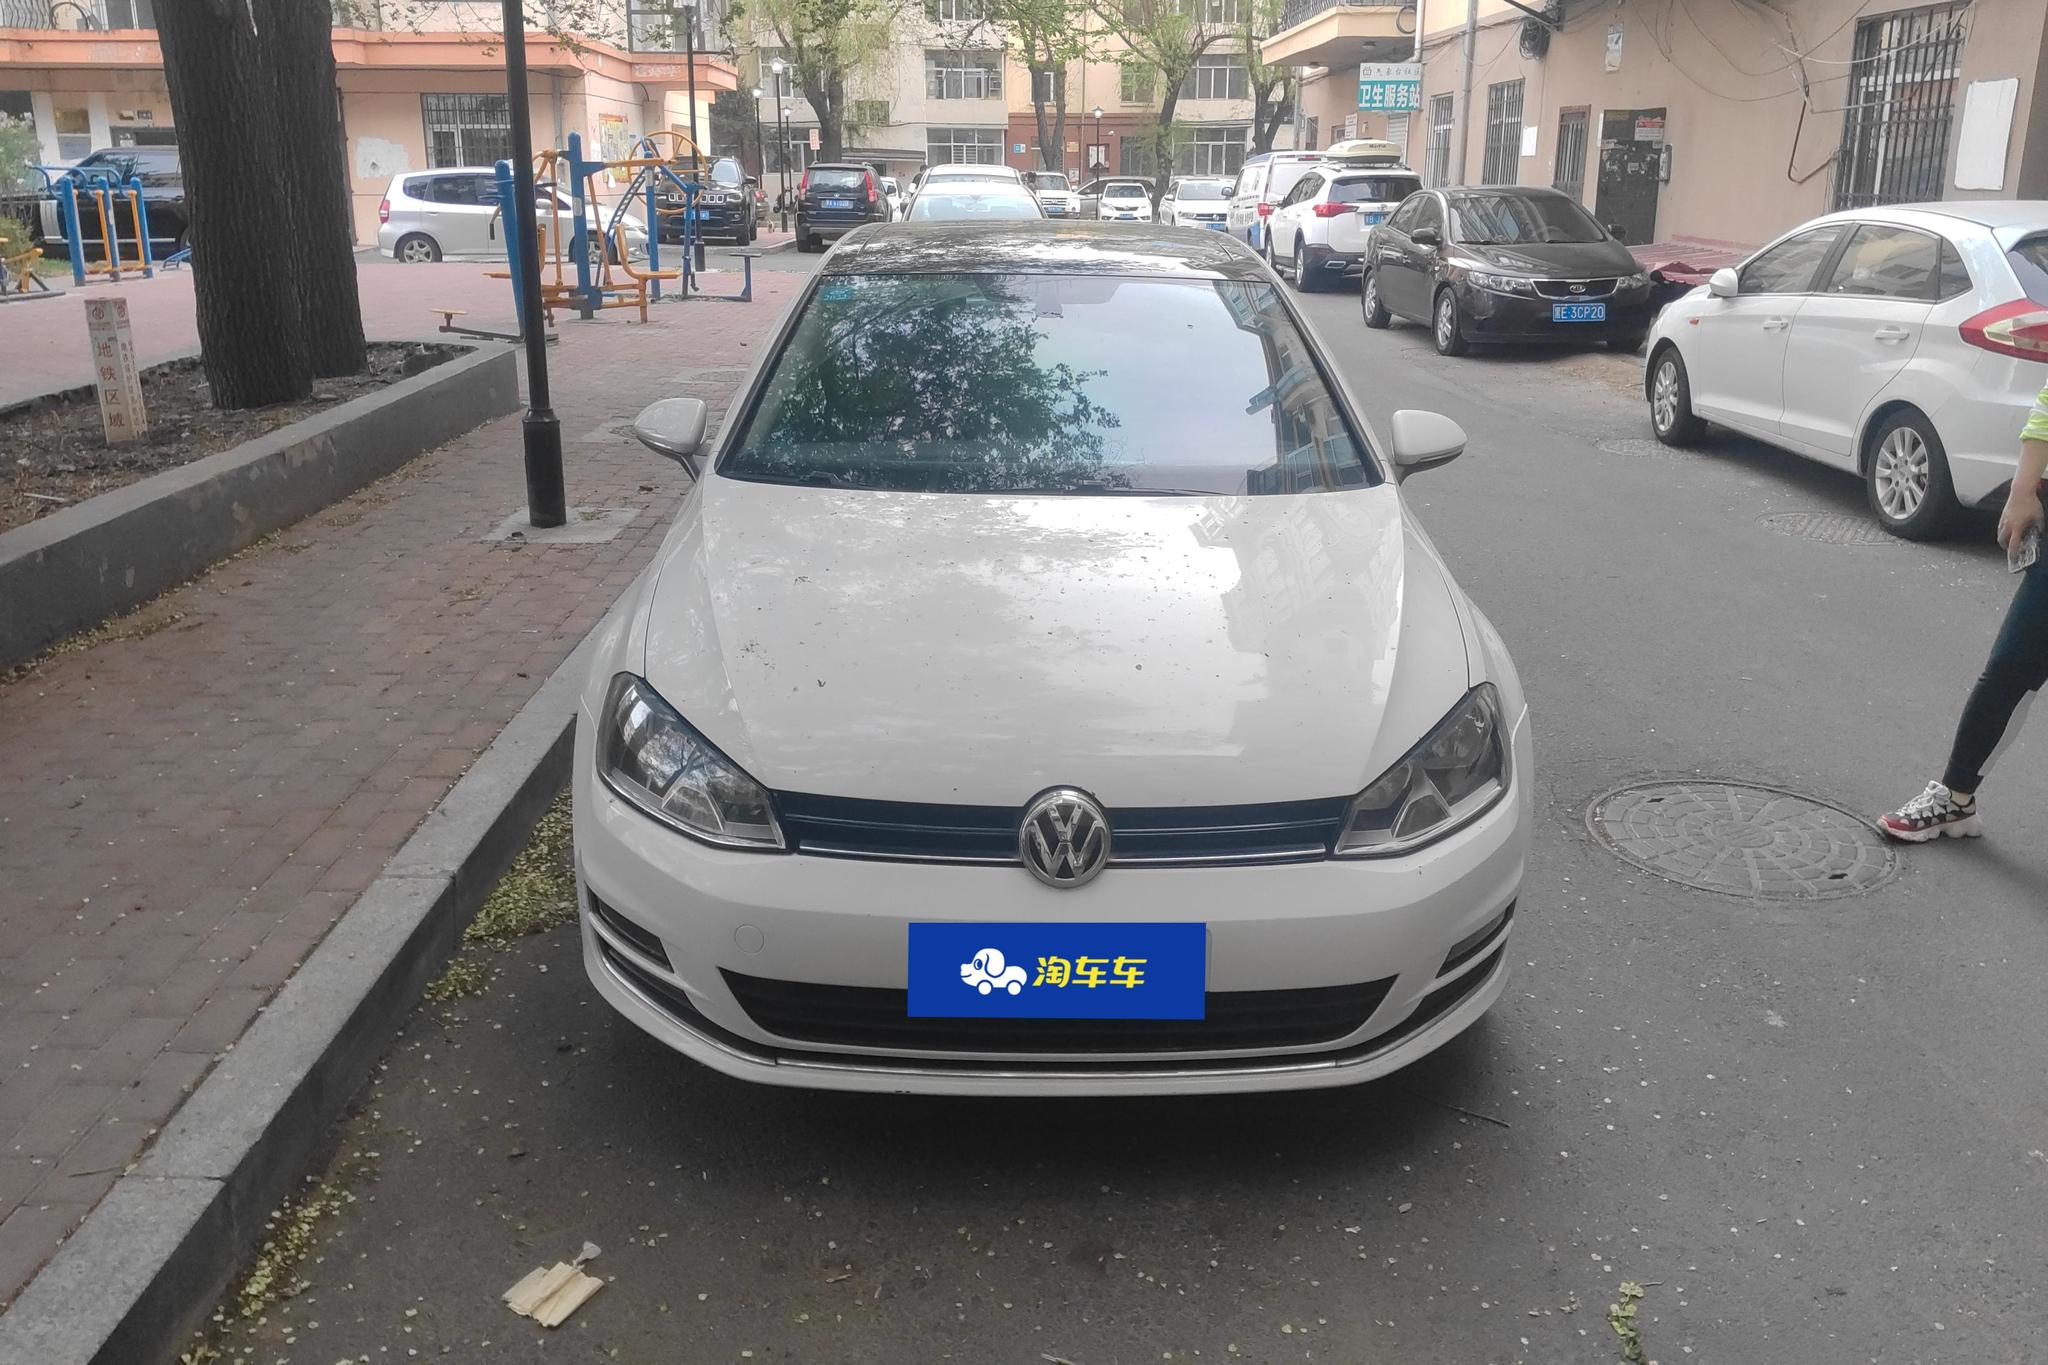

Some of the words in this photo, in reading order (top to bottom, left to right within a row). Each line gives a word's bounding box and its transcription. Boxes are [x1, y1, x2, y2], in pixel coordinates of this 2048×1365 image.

[1359, 83, 1420, 108] 卫生服务站
[97, 341, 125, 428] 地铁区域
